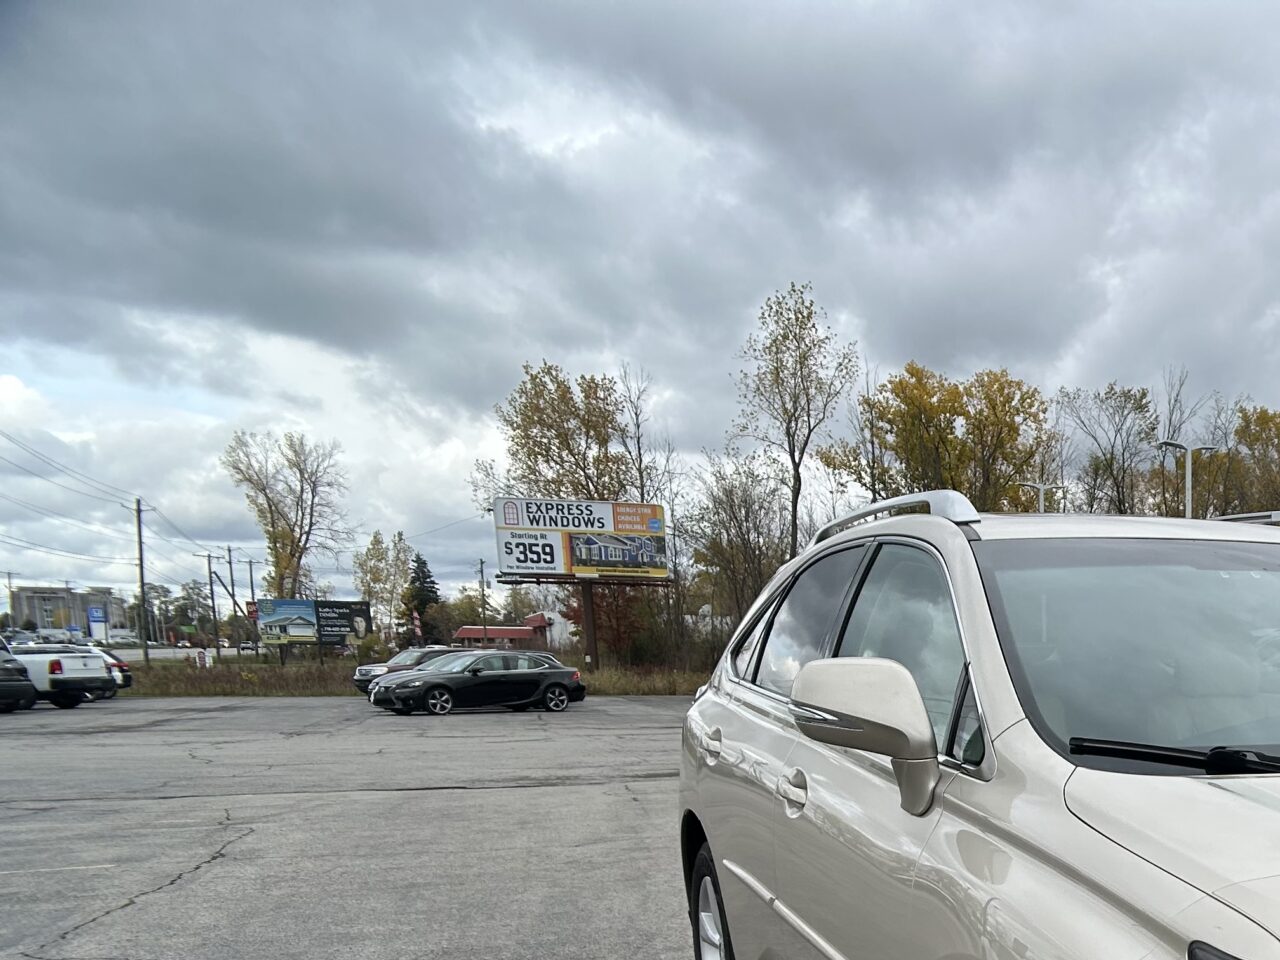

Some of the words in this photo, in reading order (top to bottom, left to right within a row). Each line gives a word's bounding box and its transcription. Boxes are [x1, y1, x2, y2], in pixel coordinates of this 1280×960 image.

[525, 502, 593, 516] EXPRESS
[527, 514, 605, 529] WINDOWS
[510, 532, 538, 541] Starting
[504, 541, 555, 564] $359
